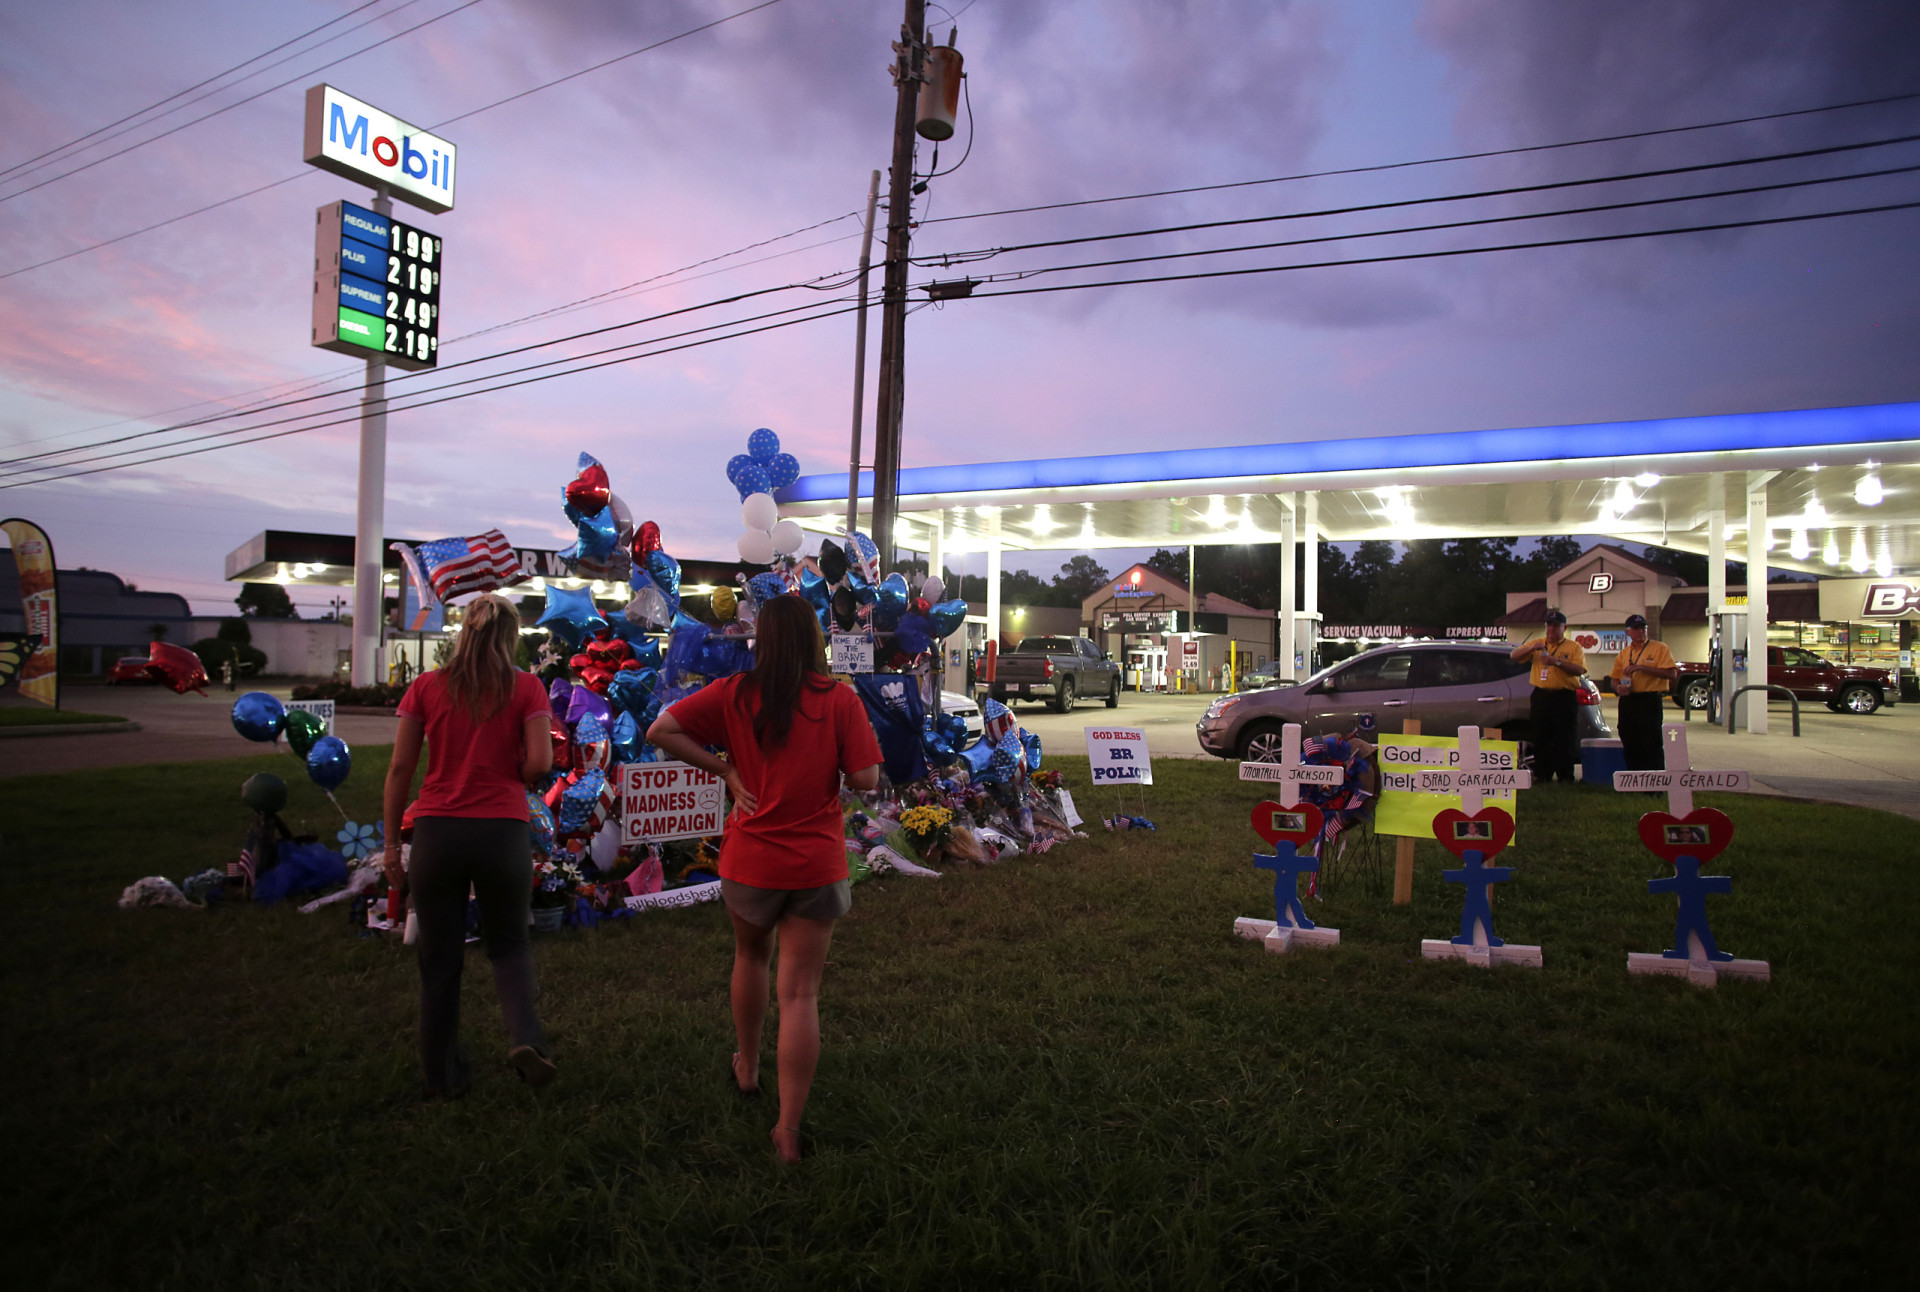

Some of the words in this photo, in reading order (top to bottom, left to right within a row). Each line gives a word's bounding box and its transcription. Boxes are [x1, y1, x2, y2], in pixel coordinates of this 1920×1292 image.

[329, 102, 449, 191] Mobil
[343, 213, 387, 237] REGULAR
[342, 248, 366, 264] PLUS
[340, 283, 382, 304] SUPREME
[1589, 574, 1612, 592] B
[1323, 626, 1360, 638] SERVICE
[1361, 625, 1402, 637] VACUUM
[1445, 627, 1482, 638] EXPRESS
[833, 636, 850, 645] HOME
[854, 637, 865, 645] OF
[837, 652, 866, 662] BRAVE
[1092, 731, 1112, 740] GOD
[1113, 731, 1141, 741] BLESS
[1109, 748, 1134, 760] BR
[1449, 750, 1511, 767] pase
[631, 769, 678, 790] STOP
[683, 768, 717, 786] THE
[1242, 766, 1282, 780] MONTRELL
[1288, 769, 1334, 782] JACKSON
[1422, 773, 1451, 788] BRAD
[1458, 773, 1516, 787] GARAFOLA
[1619, 773, 1673, 788] MATTHEW
[1679, 773, 1739, 788] GERALD
[626, 791, 696, 814] MADNESS
[630, 812, 716, 837] CAMPAIGN
